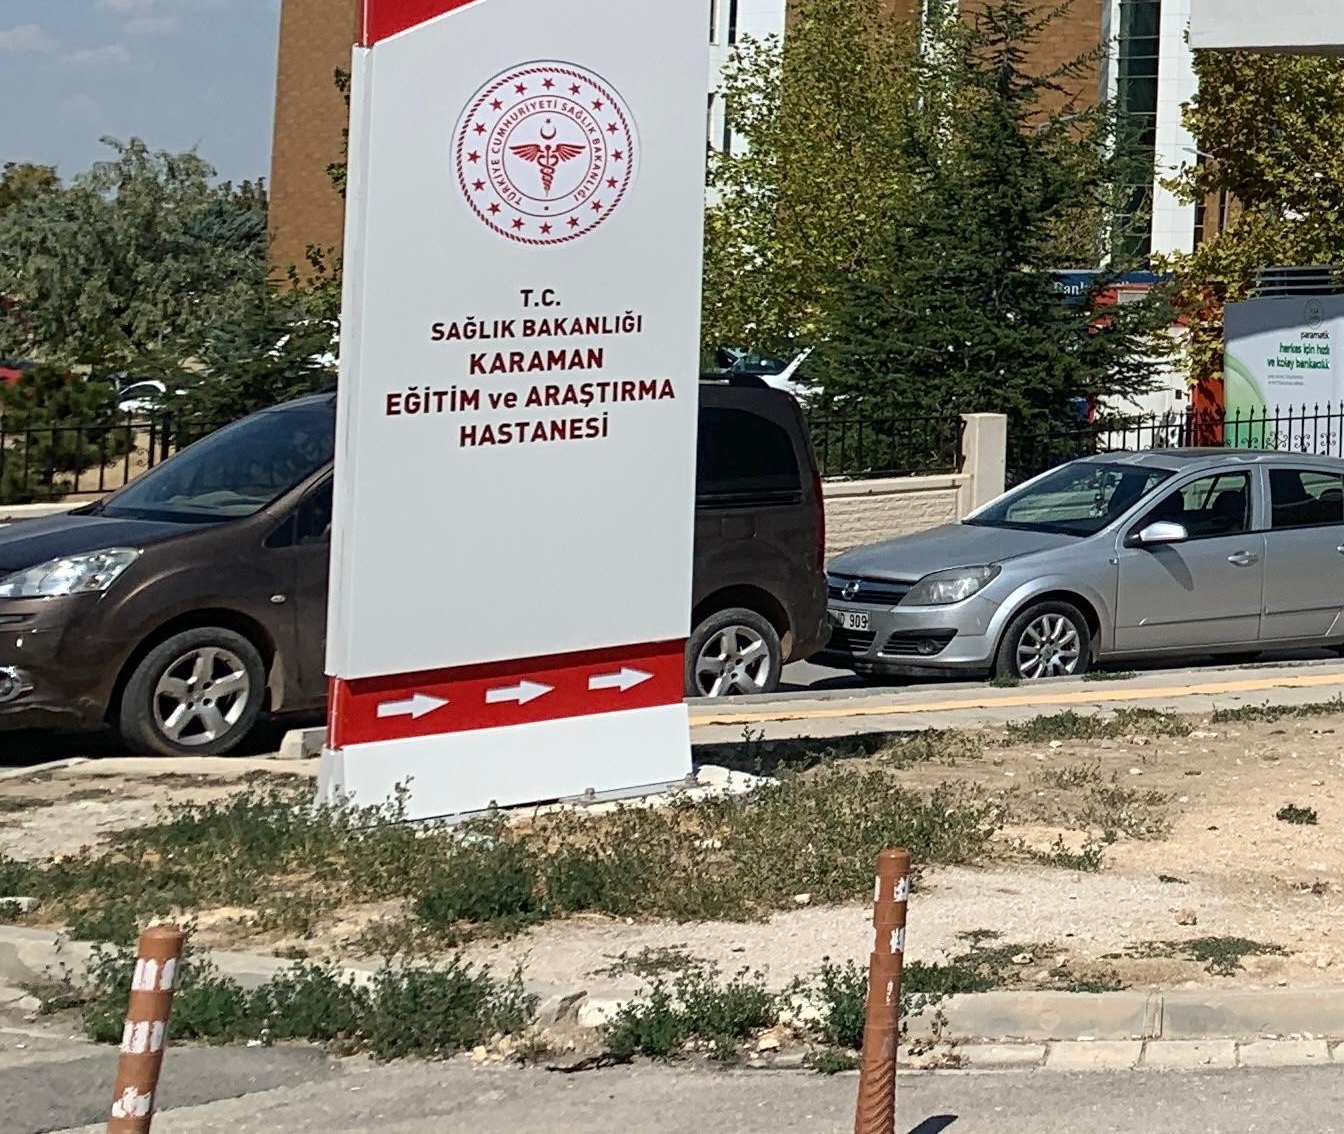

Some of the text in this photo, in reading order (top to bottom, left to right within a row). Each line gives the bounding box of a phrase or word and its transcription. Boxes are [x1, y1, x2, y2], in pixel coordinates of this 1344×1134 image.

[491, 99, 603, 207] TÜRKİYE CUMHURİYETİ SAĞLIK BAKANLIĞI
[520, 288, 561, 307] T.C.
[431, 310, 643, 341] SAĞLIK BAKANLIĞI
[469, 348, 605, 375] KARAMAN
[386, 378, 676, 416] EĞİTİM ve ARAŞTIRMA
[459, 412, 609, 447] HASTANESİ
[849, 613, 868, 628] 909
